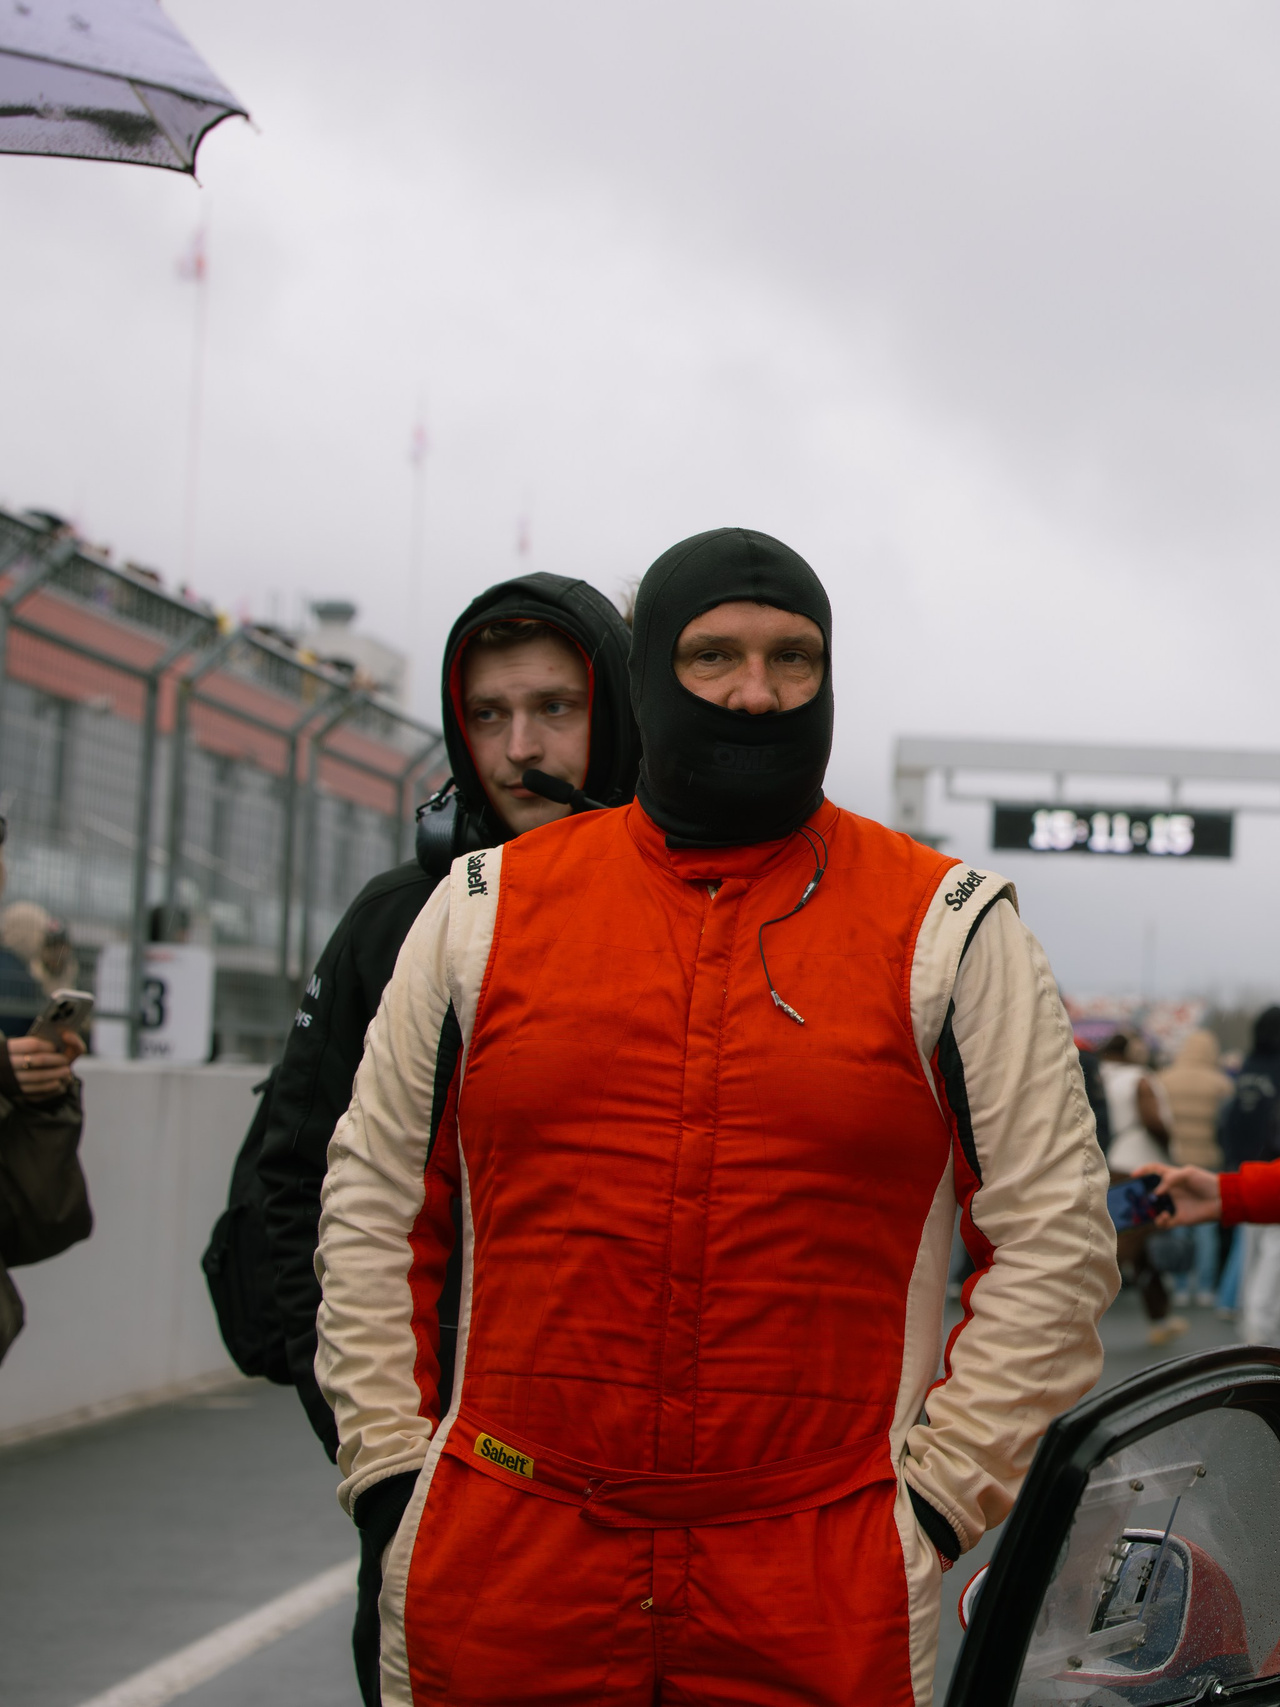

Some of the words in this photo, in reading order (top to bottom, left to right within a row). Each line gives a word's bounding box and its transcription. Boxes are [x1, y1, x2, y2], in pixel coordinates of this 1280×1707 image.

[712, 746, 775, 772] OMP
[1029, 808, 1194, 855] 15:11:15
[467, 852, 488, 897] Sabelt
[944, 869, 987, 912] Sabelt
[480, 1438, 529, 1475] Sabelt
